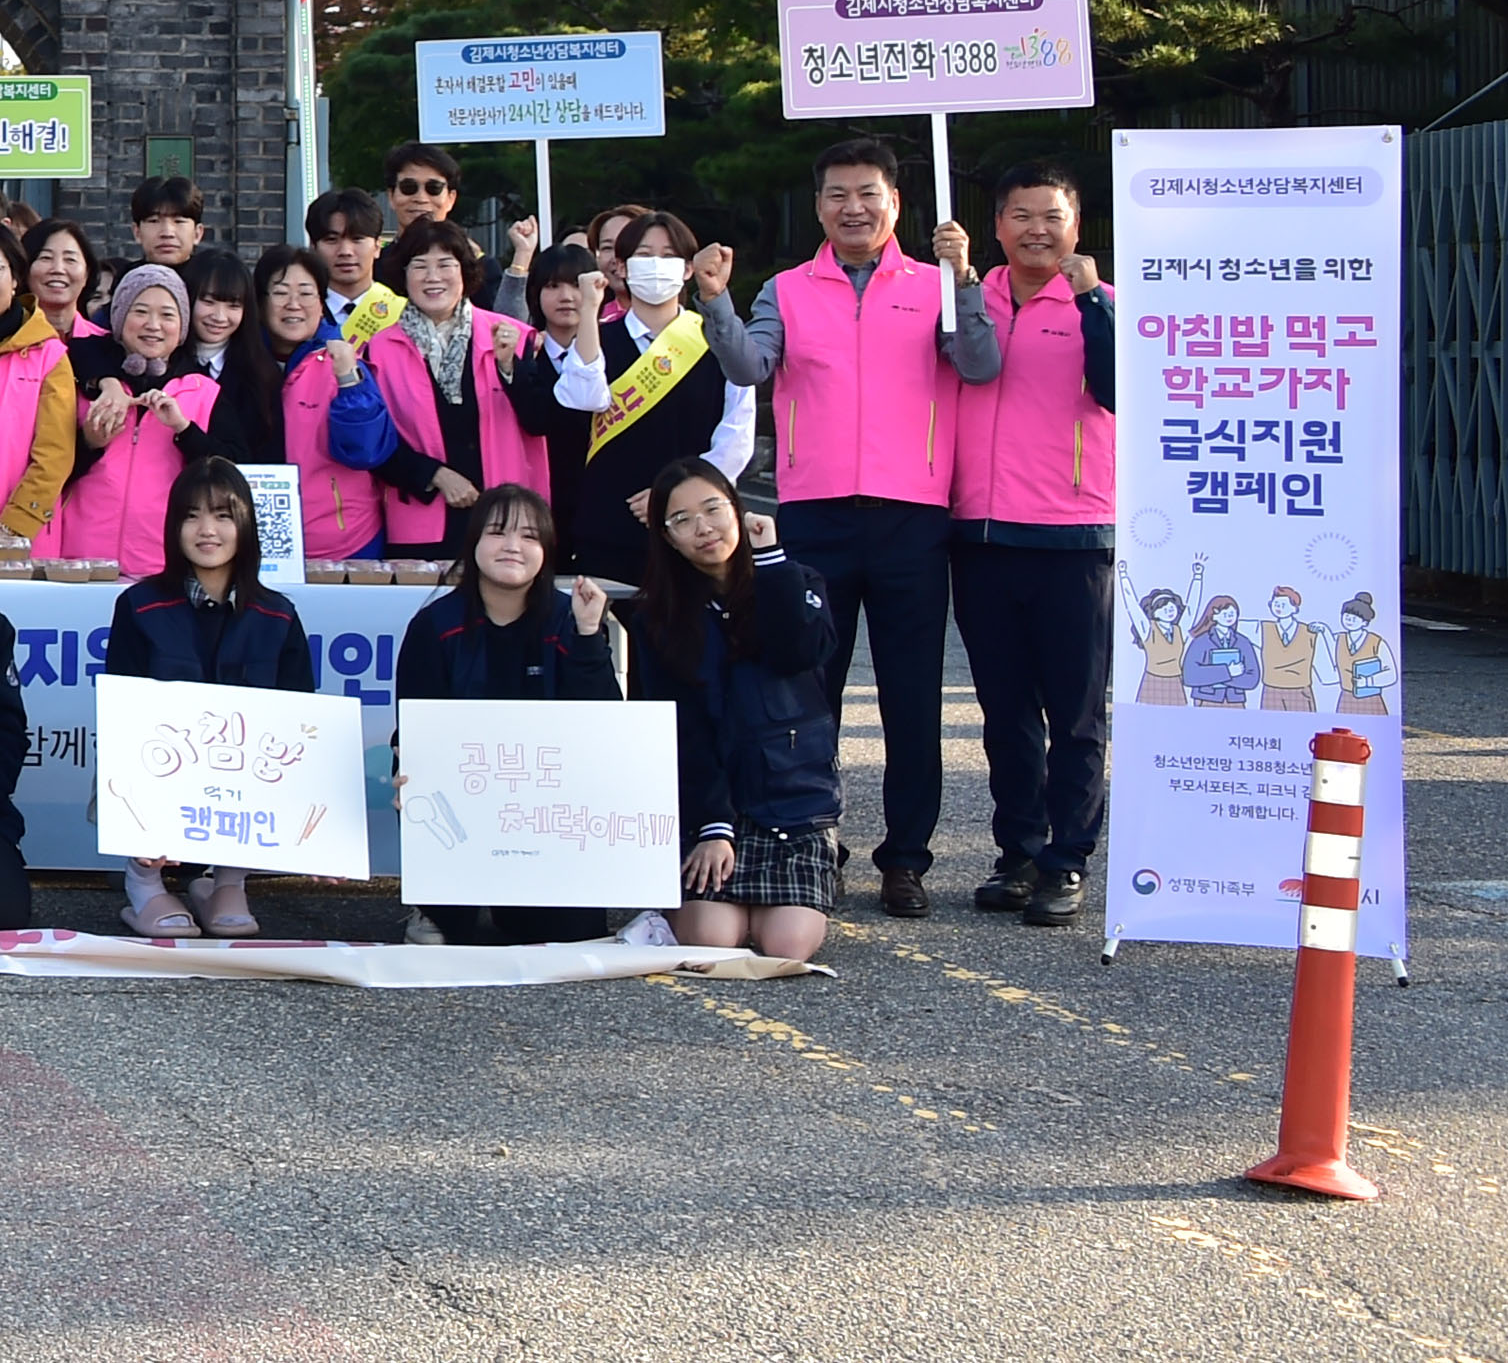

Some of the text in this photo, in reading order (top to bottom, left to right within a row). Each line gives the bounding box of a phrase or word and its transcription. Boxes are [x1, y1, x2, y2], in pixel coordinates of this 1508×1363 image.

[469, 41, 620, 62] 김제시청소년상담복지센터
[803, 40, 936, 85] 청소년전화
[941, 41, 997, 75] 1388
[435, 67, 577, 95] 혼자서 해결못할 고민이 있을때
[447, 98, 647, 126] 전문상담사가 24시간 상담을 해드립니다.
[1149, 176, 1363, 196] 김제시청소년상담복지센터
[1141, 257, 1373, 281] 김제시 청소년을 위한
[1137, 313, 1378, 358] 아침밥 먹고
[1162, 365, 1351, 411] 학교가자
[1159, 418, 1345, 464] 급식지원
[1186, 470, 1326, 517] 캠페인
[141, 710, 305, 783] 아침밥
[1228, 736, 1282, 751] 지역사회
[458, 742, 562, 795] 공부도
[1153, 755, 1232, 772] 청소년안전망
[203, 785, 242, 802] 먹기
[1168, 779, 1252, 796] 부모서포터즈,
[1257, 783, 1297, 798] 피크닉
[1210, 803, 1299, 821] 가 함께합니다.
[1168, 877, 1255, 897] 성평등가족부
